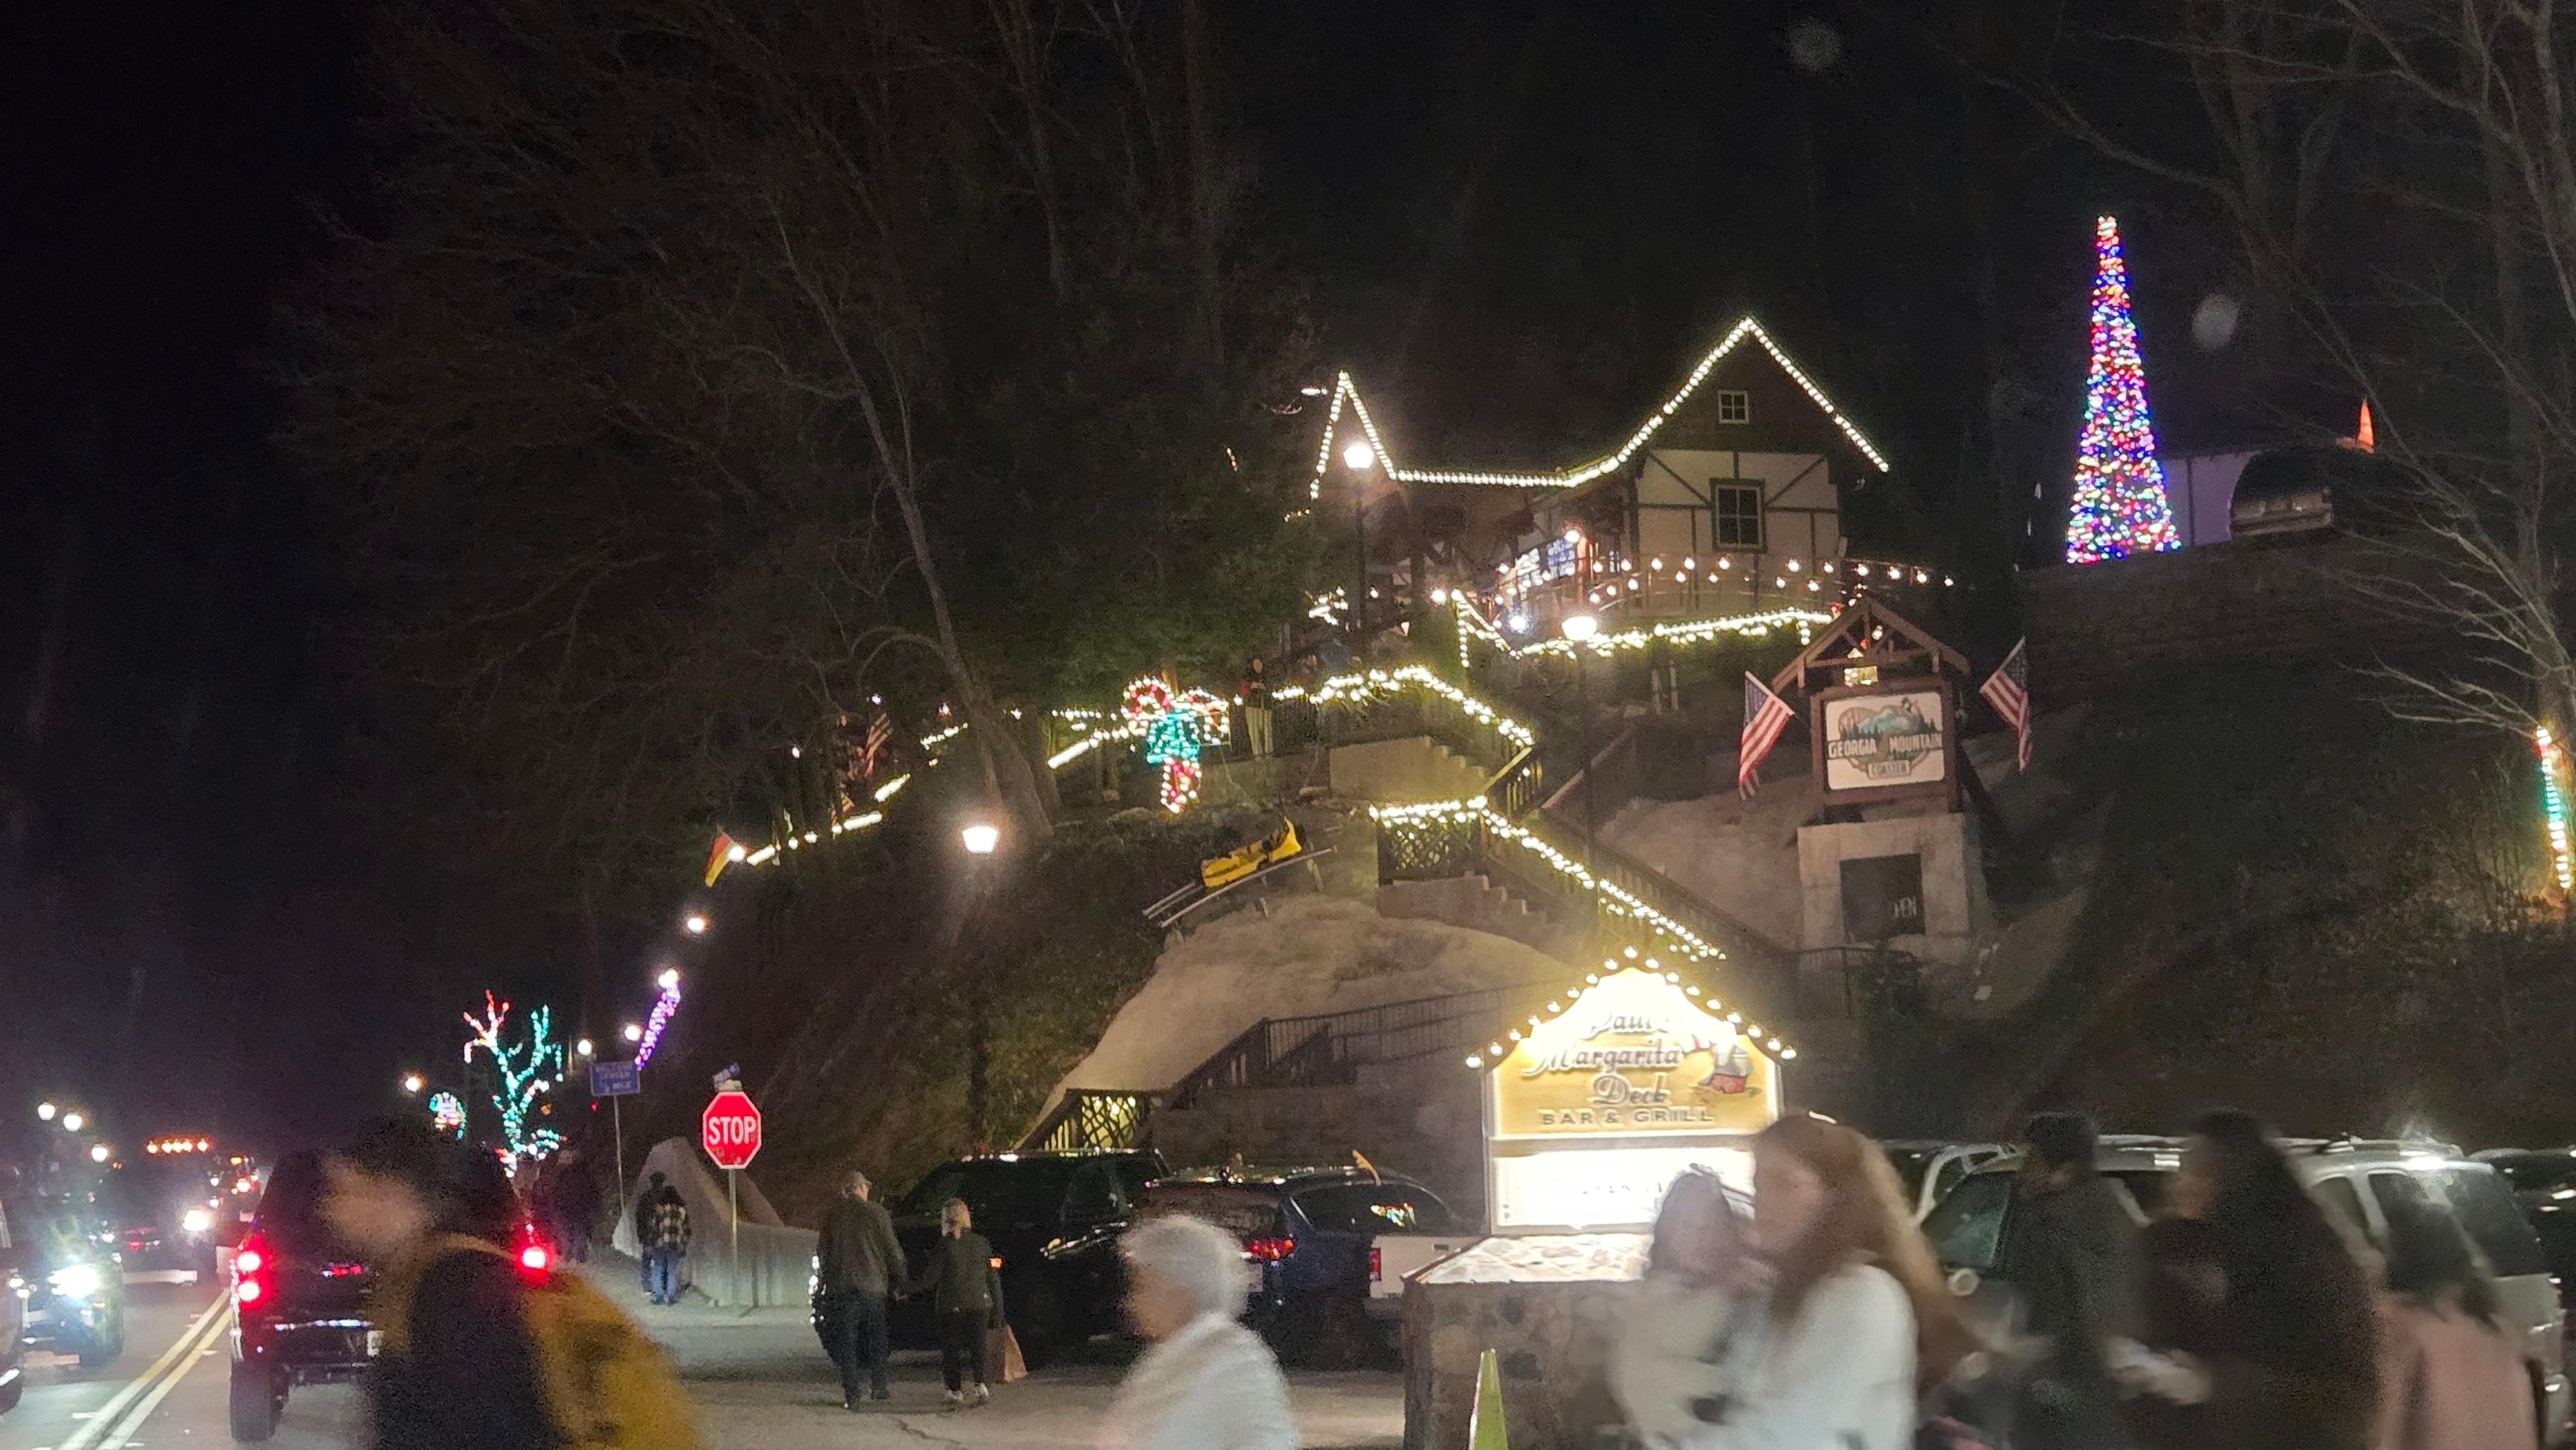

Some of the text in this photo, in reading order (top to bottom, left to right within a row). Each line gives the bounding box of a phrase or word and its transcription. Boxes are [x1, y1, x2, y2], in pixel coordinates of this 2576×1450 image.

[1828, 732, 1943, 758] GEORGIA MOUNTAIN
[1522, 1038, 1681, 1073] Margarita
[1590, 1072, 1668, 1106] Deck
[1539, 1106, 1715, 1125] BAR & GRILL
[708, 1116, 757, 1145] STOP
